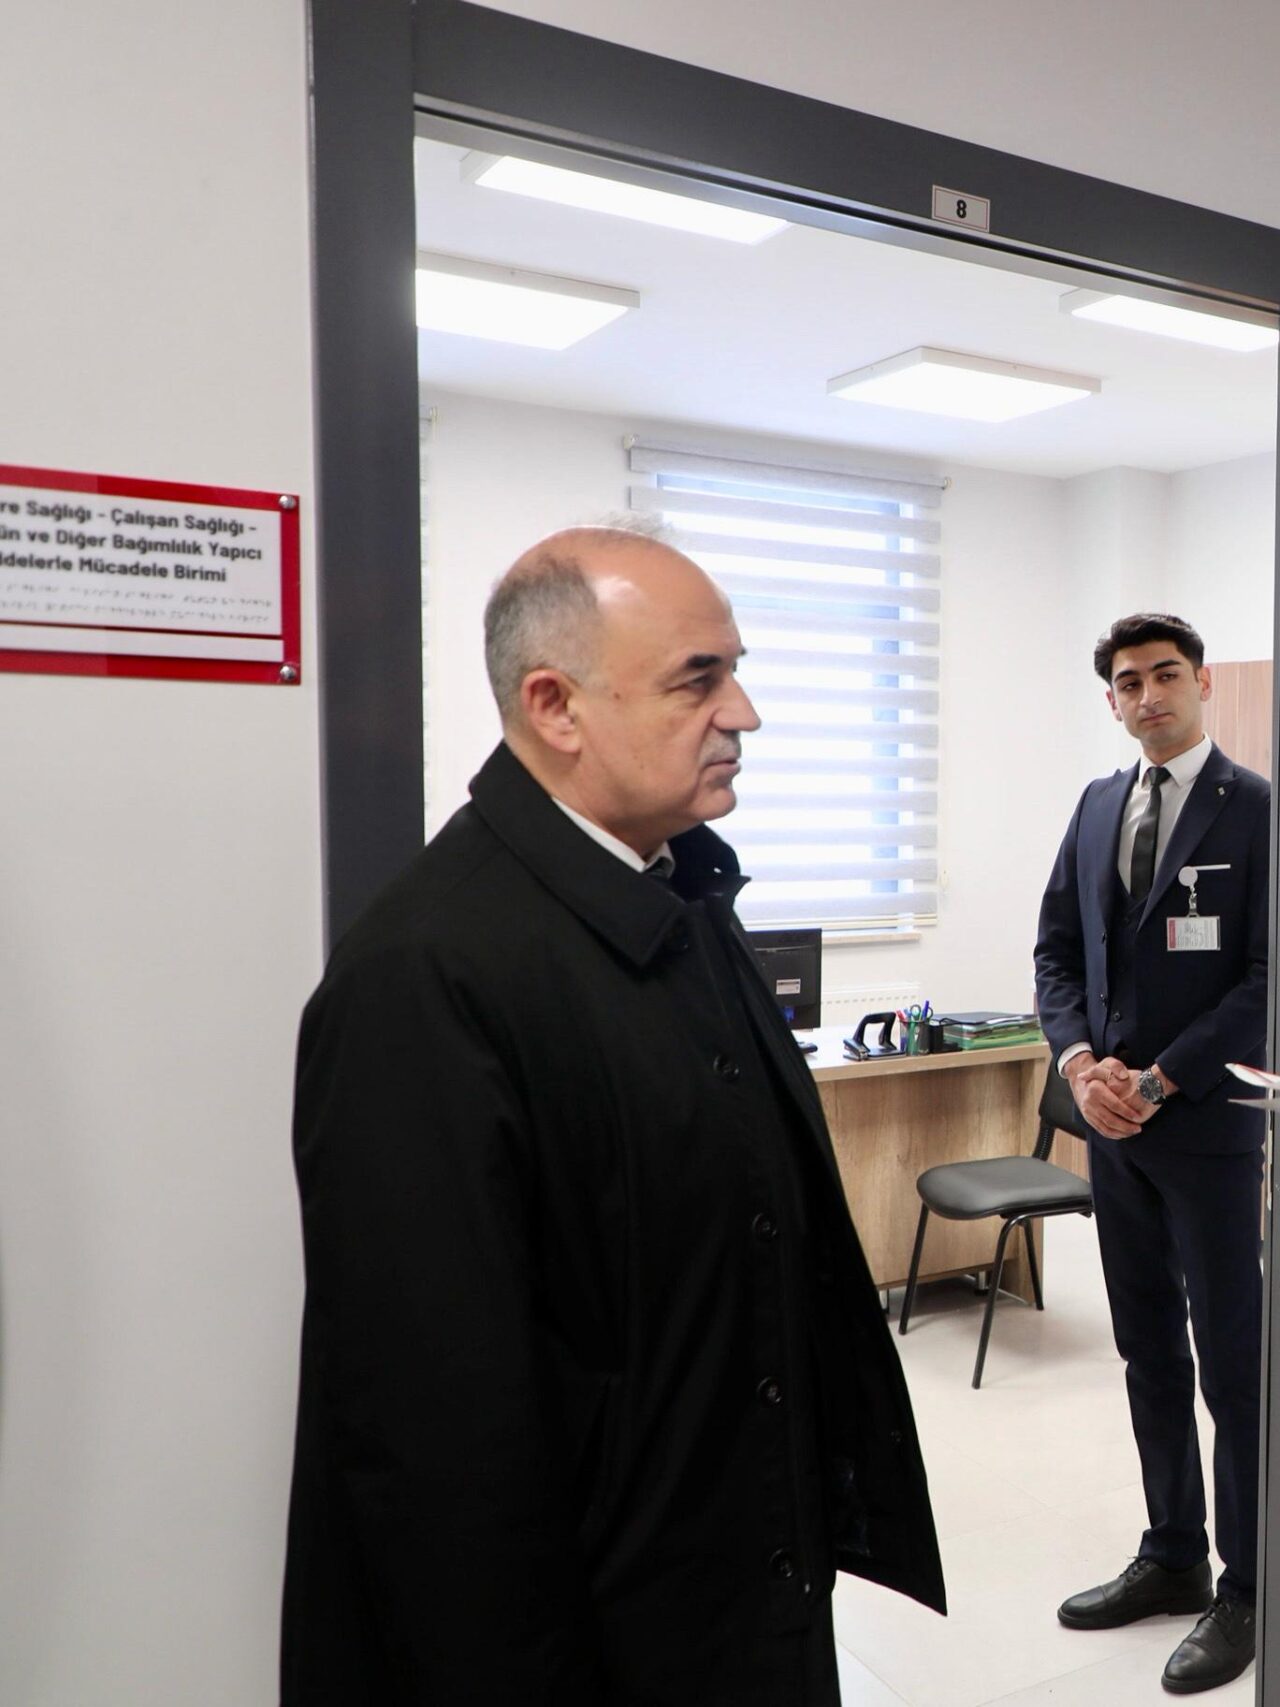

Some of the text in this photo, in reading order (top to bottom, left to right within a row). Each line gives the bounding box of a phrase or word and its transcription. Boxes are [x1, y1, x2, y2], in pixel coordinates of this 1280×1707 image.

[956, 199, 967, 218] 8
[26, 500, 92, 524] Sağlığı
[111, 508, 179, 529] Çalışan
[184, 515, 244, 537] Sağlığı
[28, 530, 49, 543] ve
[56, 530, 106, 550] Diğer
[113, 534, 202, 555] Bağımlılık
[208, 542, 262, 561] Yapıcı
[79, 557, 168, 579] Mücadele
[174, 564, 227, 582] Birimi
